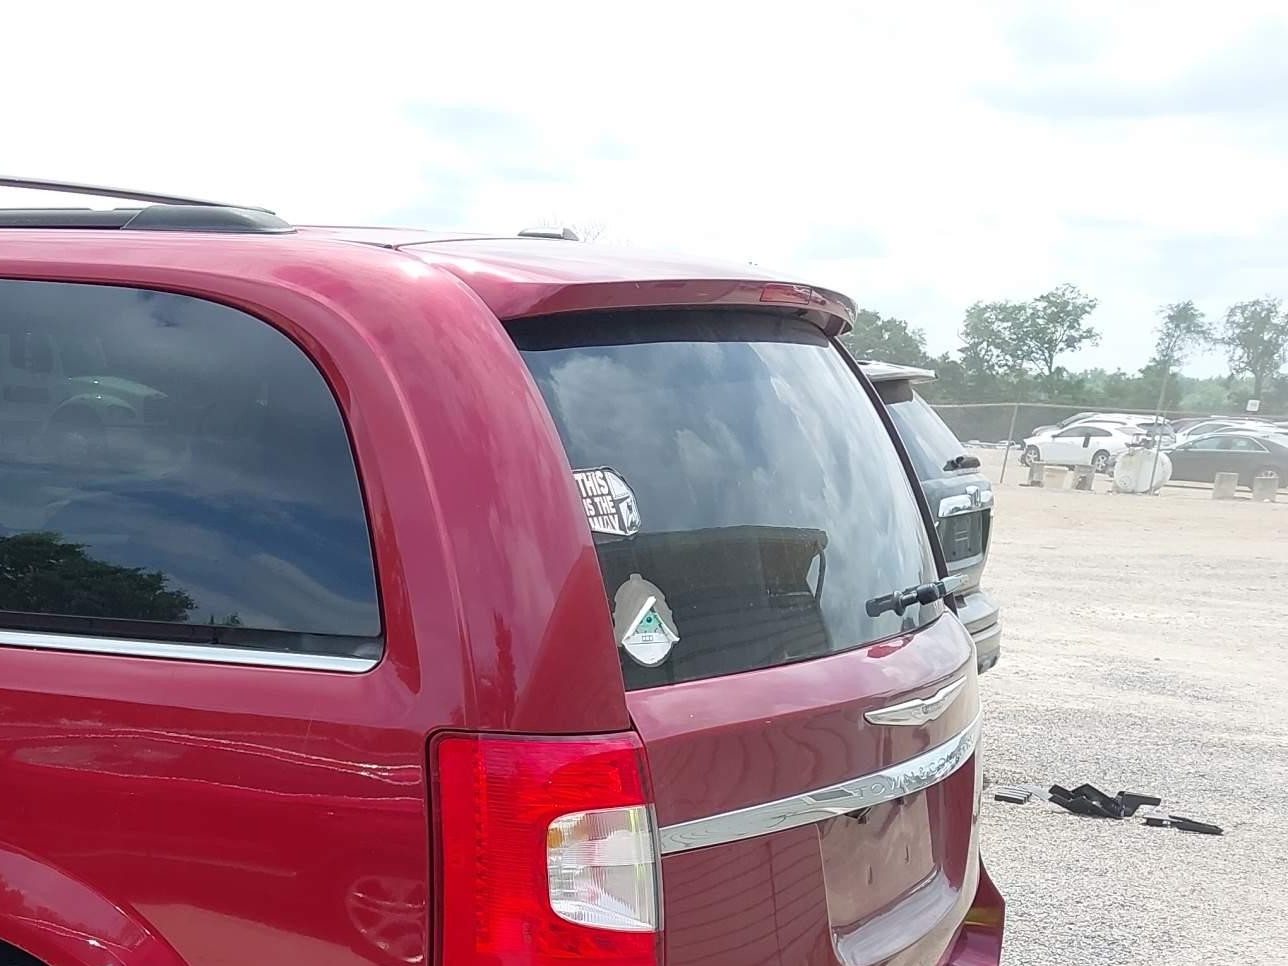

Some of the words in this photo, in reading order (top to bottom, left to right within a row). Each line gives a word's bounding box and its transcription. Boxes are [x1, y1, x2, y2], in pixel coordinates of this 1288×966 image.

[573, 470, 609, 498] THIS
[582, 498, 596, 516] IS
[593, 496, 617, 515] THE
[588, 514, 620, 531] WAY
